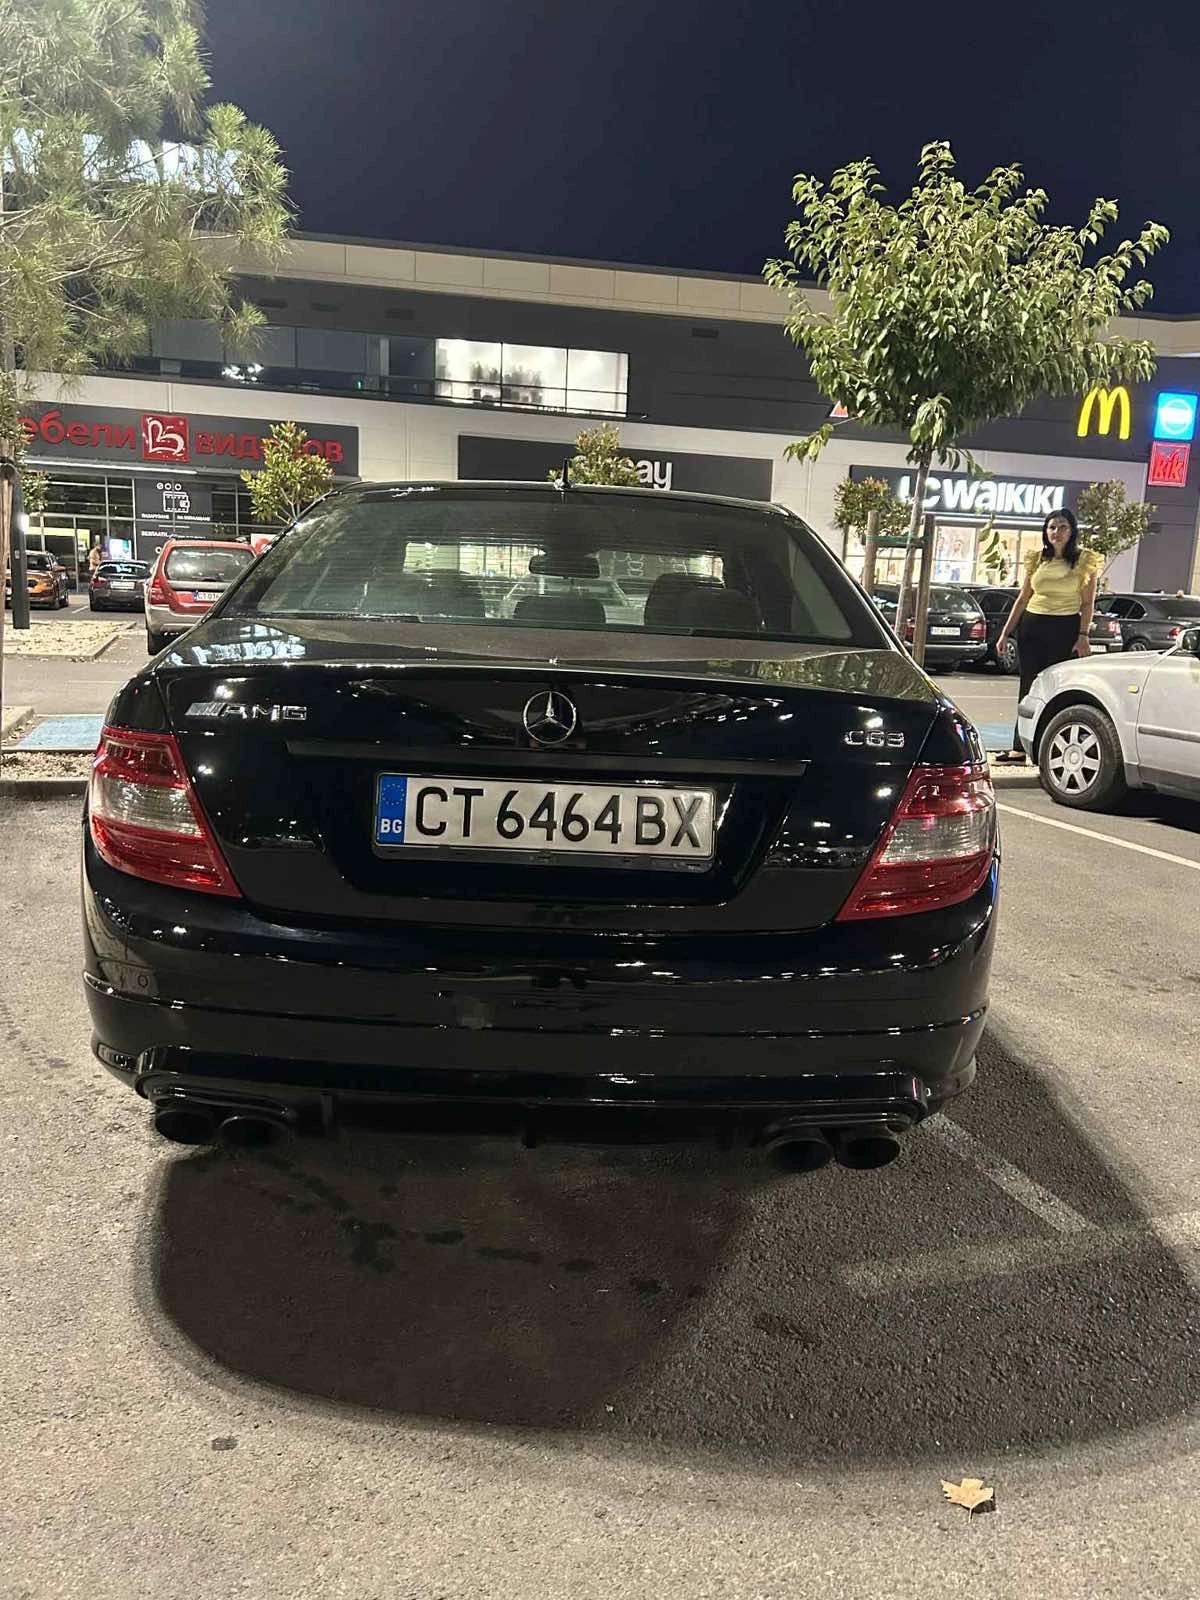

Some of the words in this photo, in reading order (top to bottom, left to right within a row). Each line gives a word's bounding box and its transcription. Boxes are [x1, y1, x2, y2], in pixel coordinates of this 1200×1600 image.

[221, 702, 307, 721] AMG
[845, 729, 904, 748] C63
[380, 818, 402, 834] BG
[415, 786, 484, 838] CT
[496, 790, 623, 844] 6464
[635, 796, 702, 848] BX
